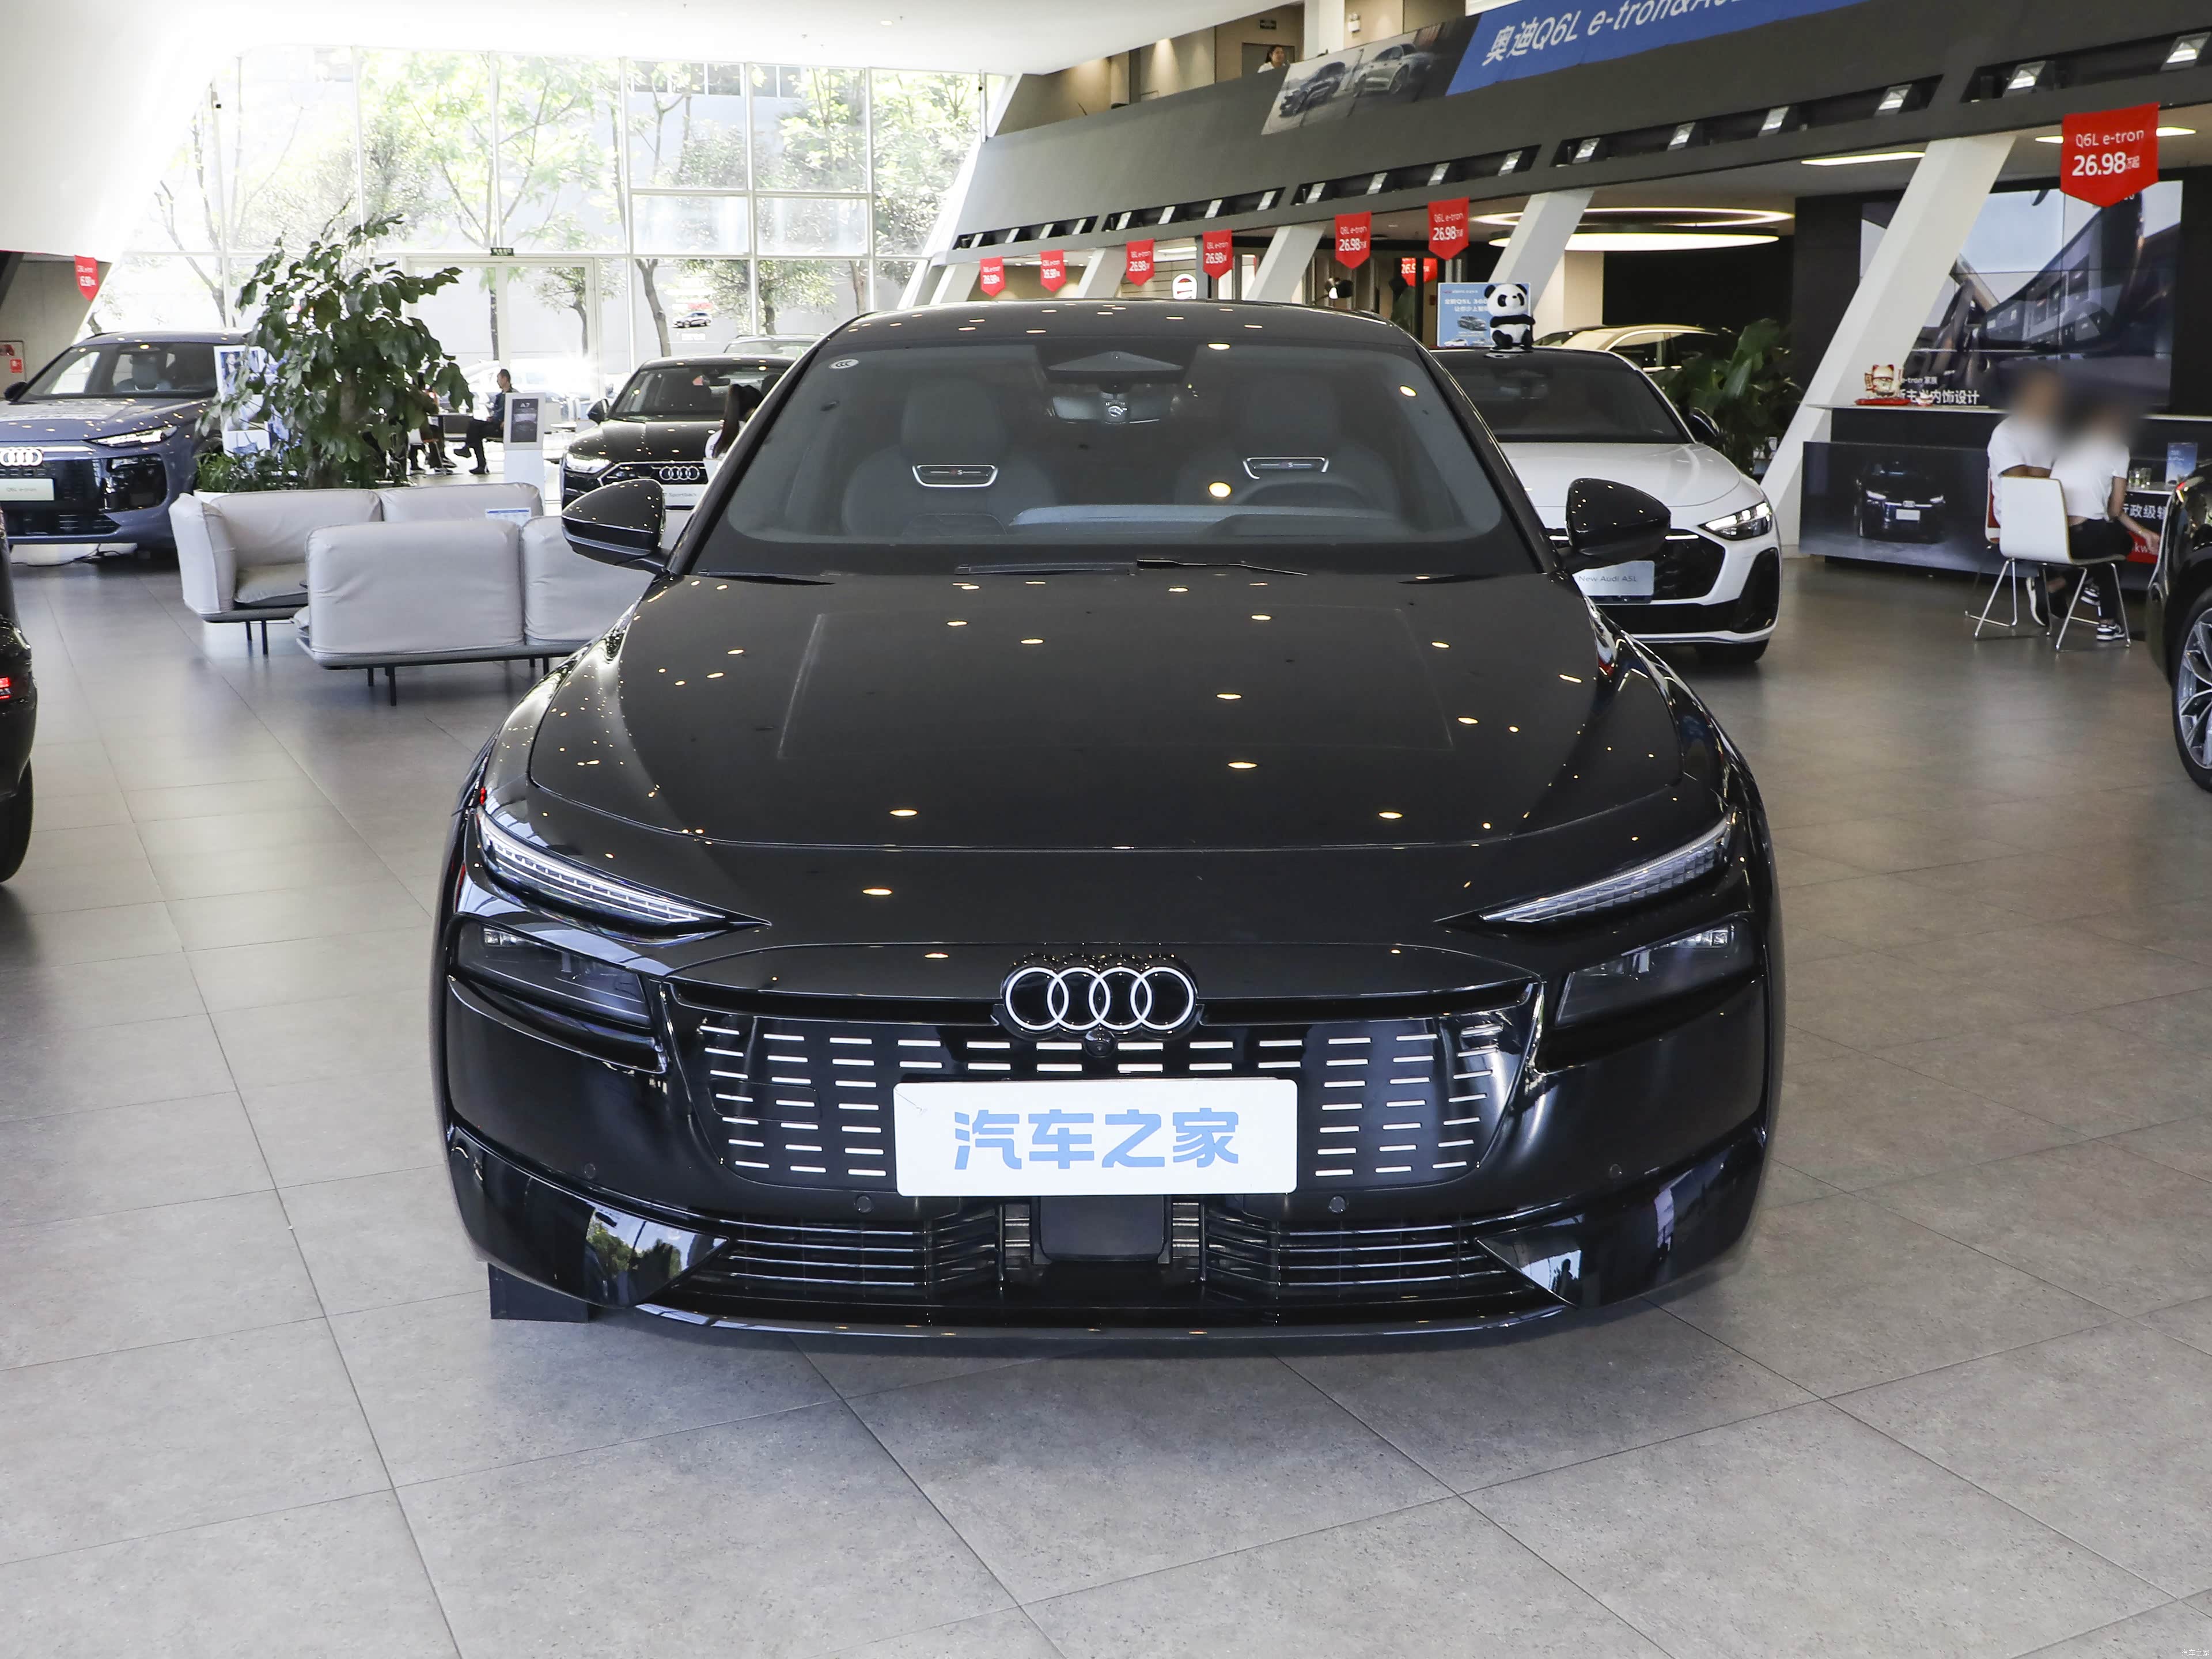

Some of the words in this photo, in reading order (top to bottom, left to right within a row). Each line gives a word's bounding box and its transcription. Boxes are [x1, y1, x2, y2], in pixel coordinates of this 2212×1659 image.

[1482, 10, 1582, 66] 奥迪Q6L
[2075, 132, 2100, 148] Q6L
[2103, 130, 2144, 145] e-tron
[954, 1107, 1239, 1170] 汽车之家
